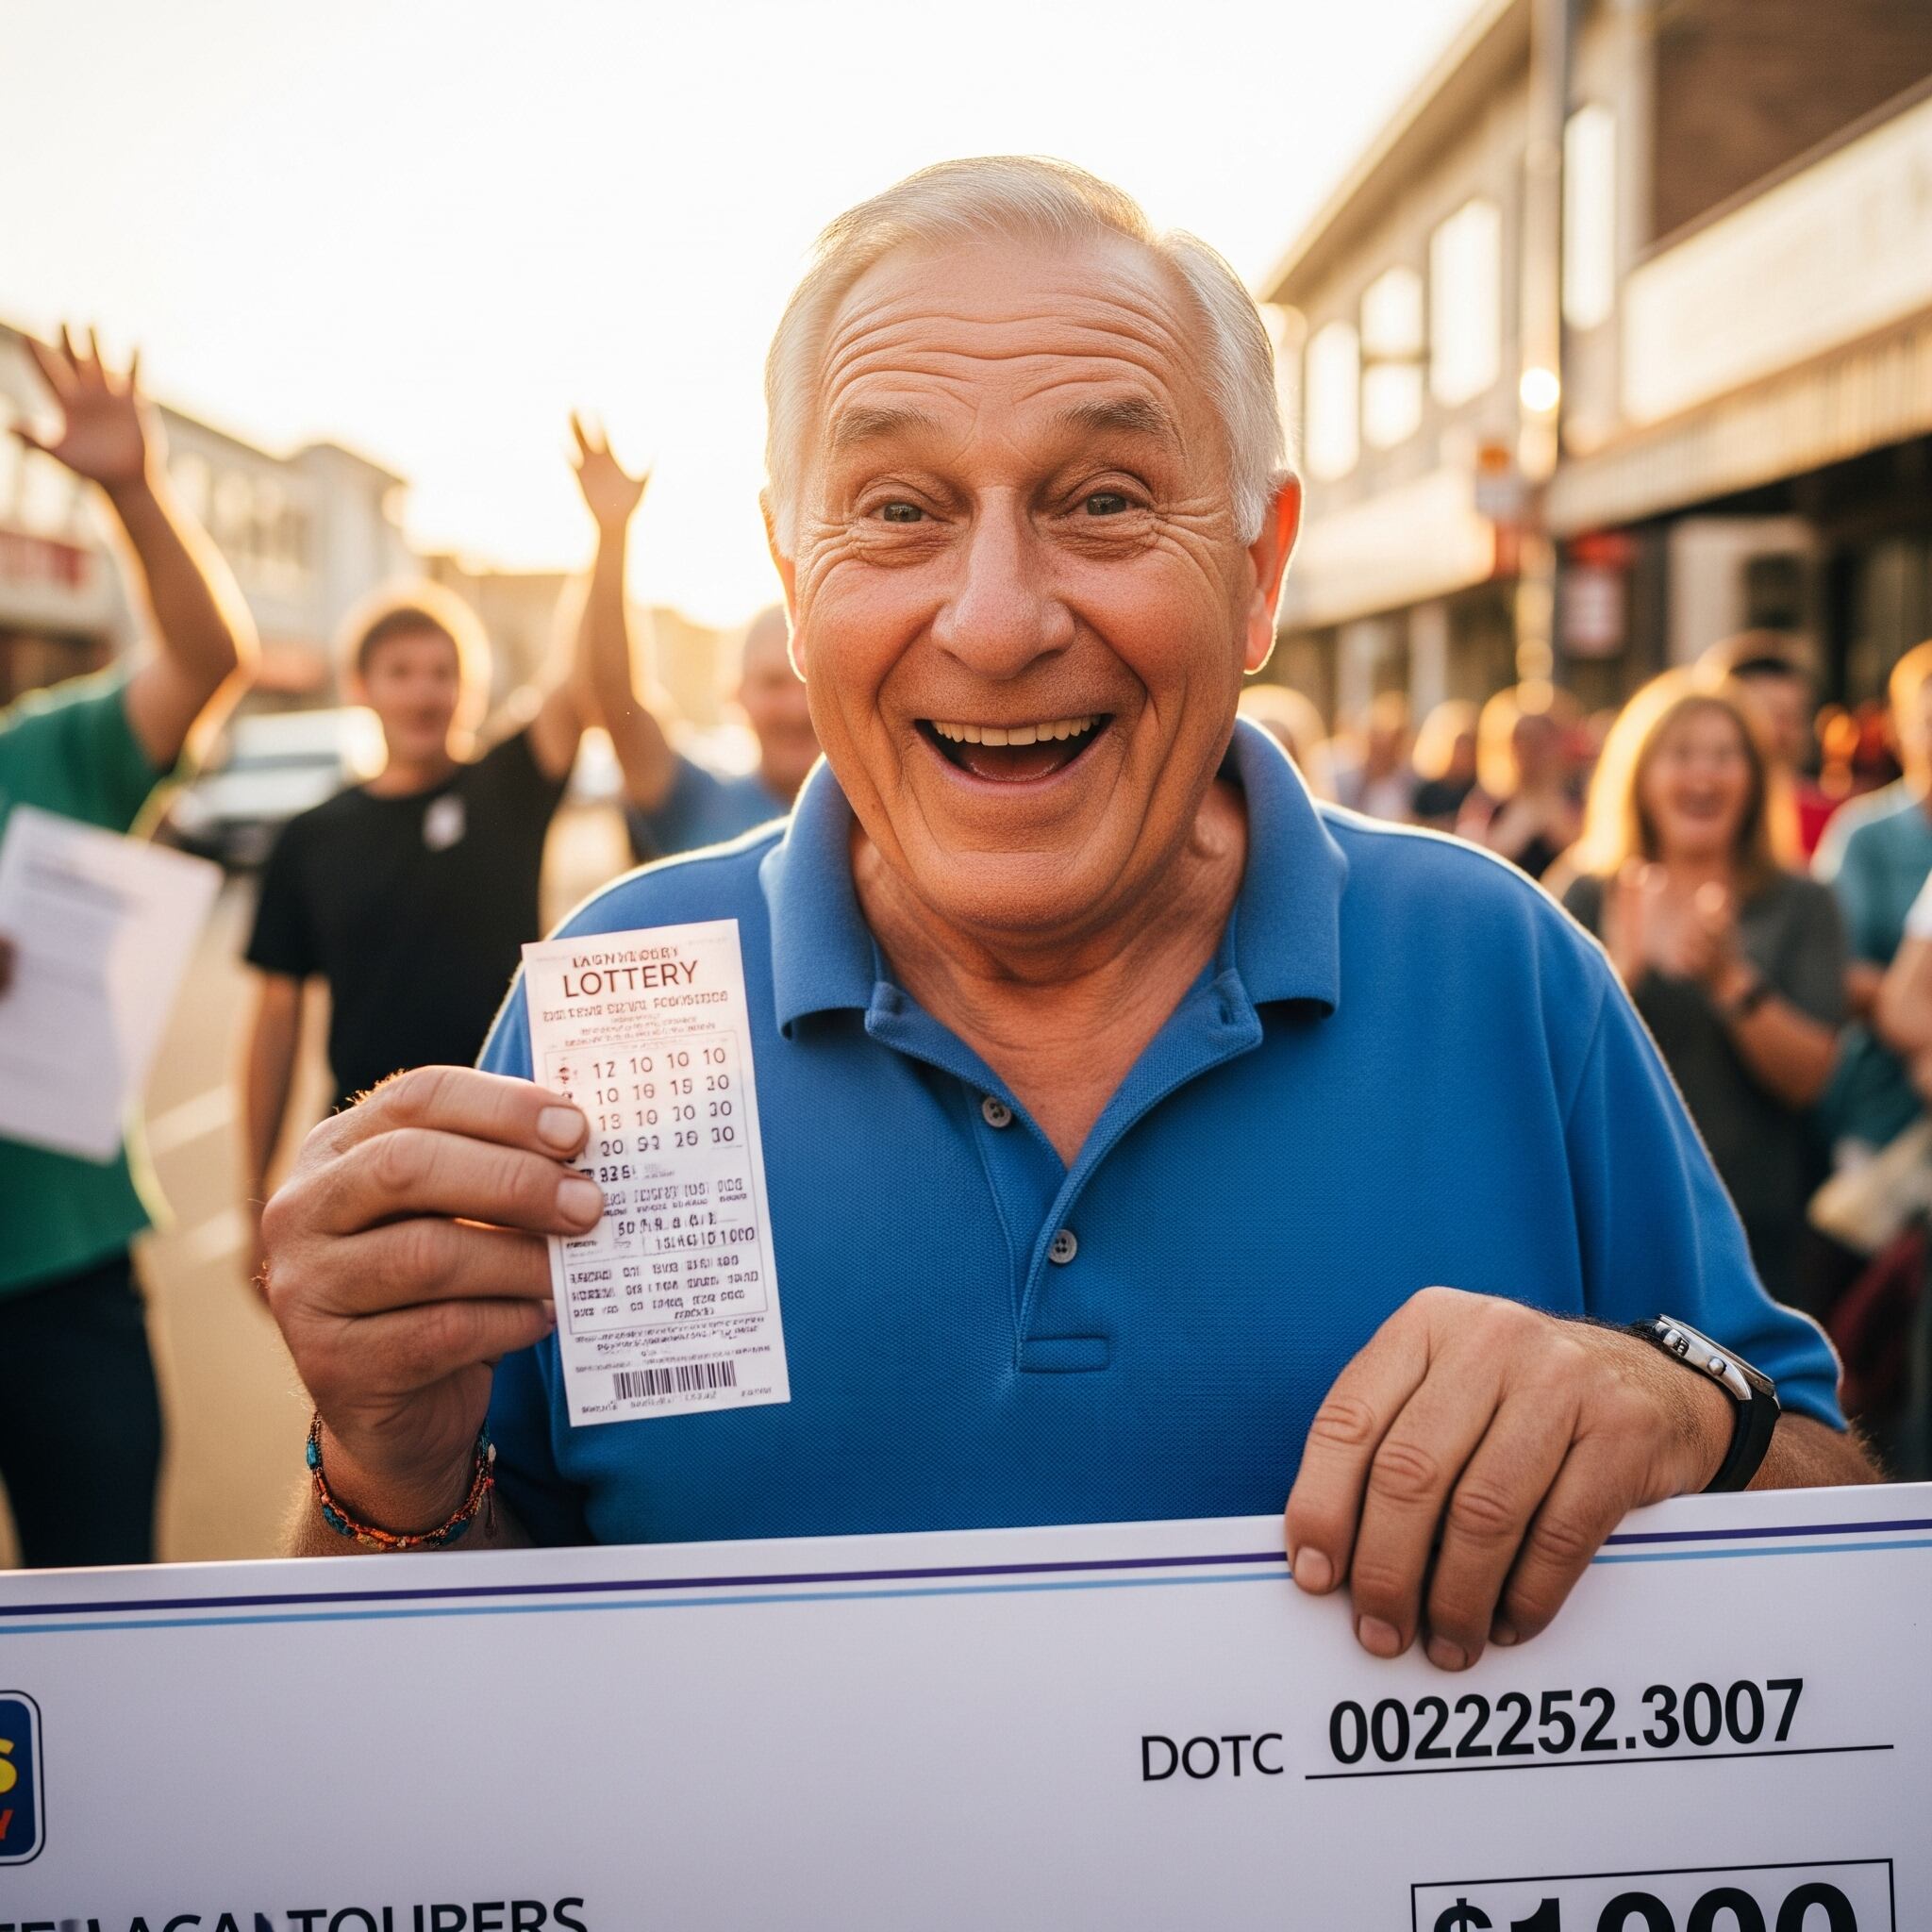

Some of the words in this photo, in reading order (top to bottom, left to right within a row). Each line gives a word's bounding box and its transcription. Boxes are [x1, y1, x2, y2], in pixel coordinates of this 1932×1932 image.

[562, 959, 698, 998] LOTTERY
[629, 1057, 654, 1074] 10
[666, 1051, 690, 1069] 10
[703, 1047, 725, 1065] 10
[596, 1087, 619, 1106] 10
[1140, 1733, 1284, 1782] DOTC
[1328, 1676, 1805, 1765] 0022252.3007
